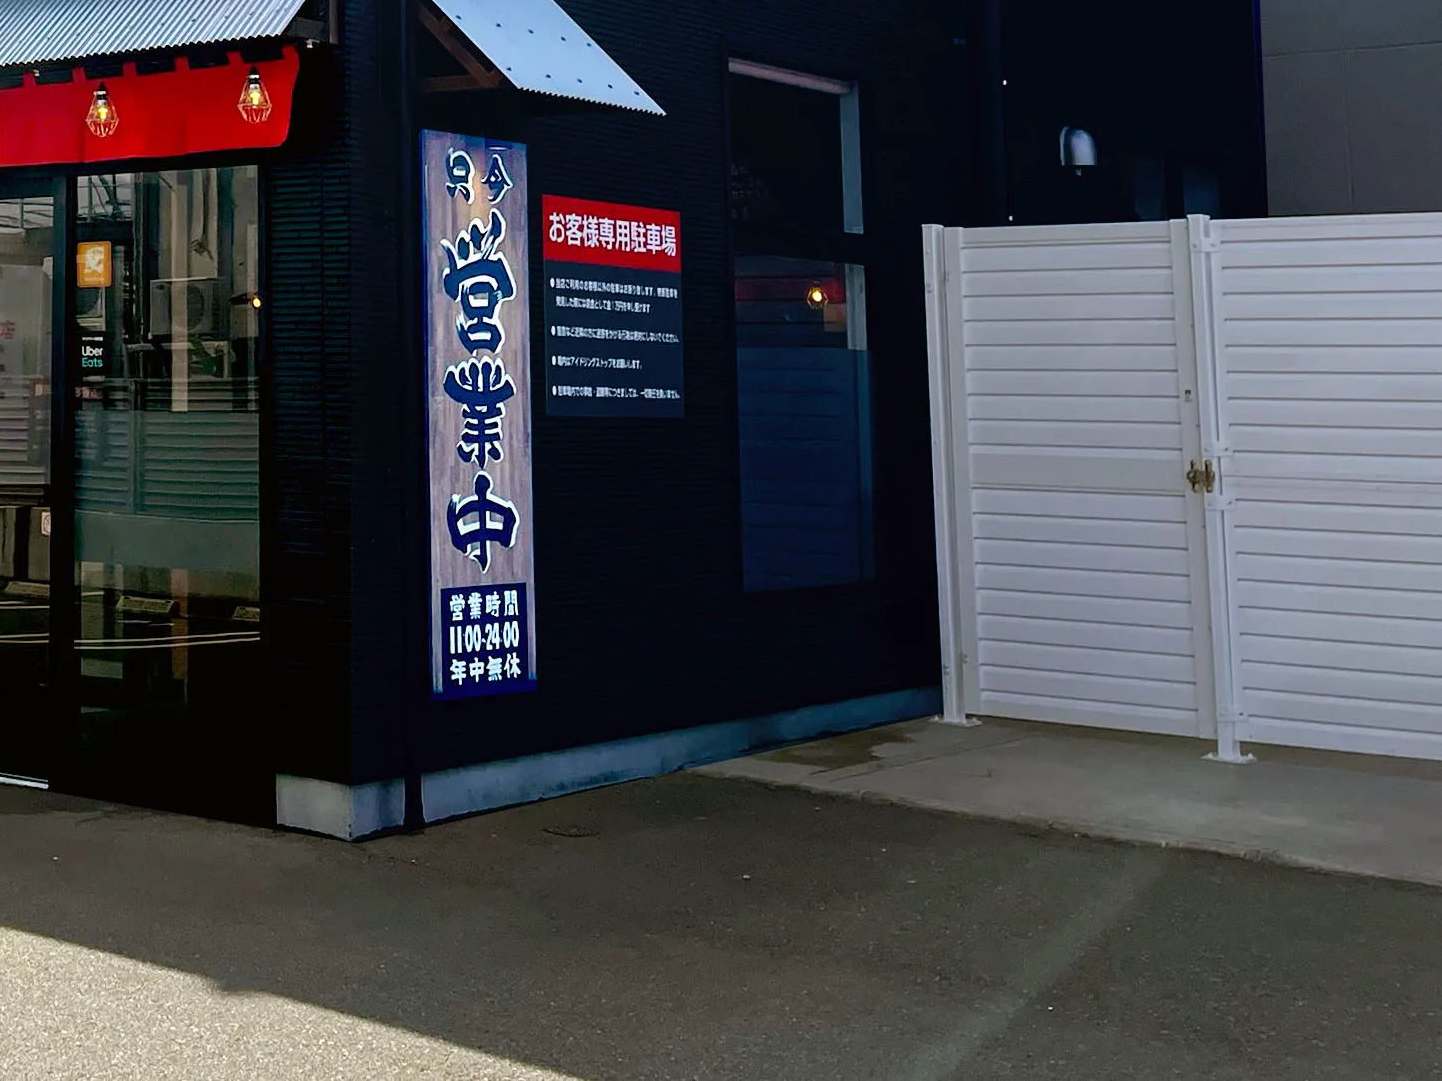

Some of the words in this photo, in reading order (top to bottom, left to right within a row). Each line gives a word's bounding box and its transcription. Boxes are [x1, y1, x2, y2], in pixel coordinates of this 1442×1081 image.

[548, 212, 677, 257] お客様専用駐車場
[81, 346, 103, 356] Uber
[81, 357, 103, 367] Eats
[440, 208, 517, 574] 営業中
[449, 589, 519, 621] 営業時間
[449, 652, 521, 686] 年中無休
